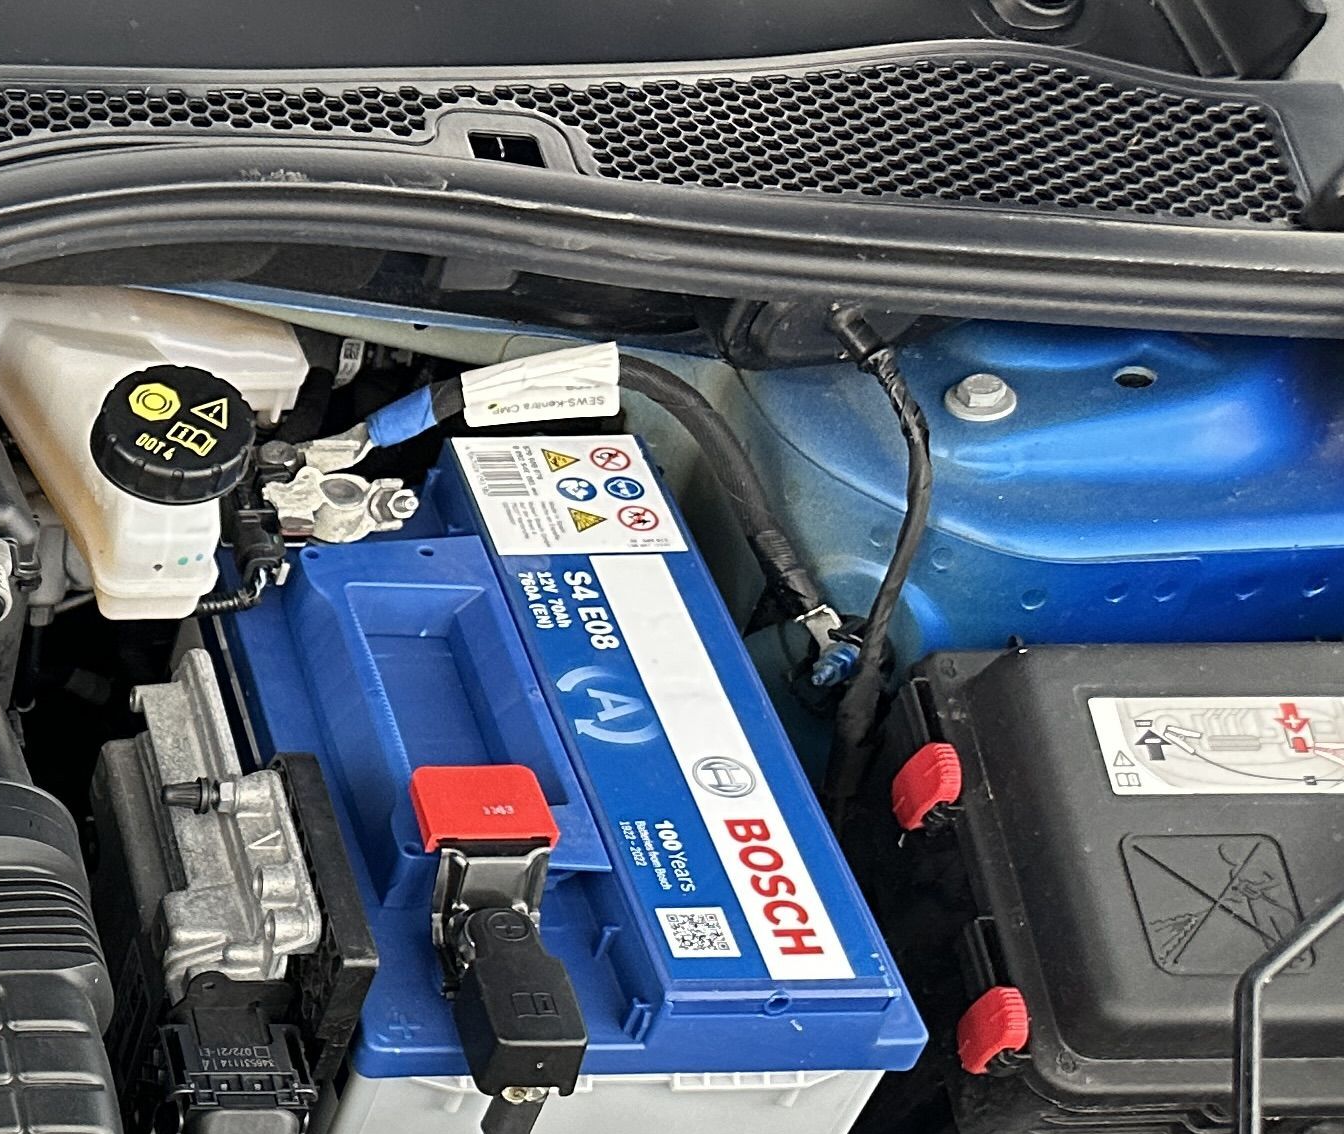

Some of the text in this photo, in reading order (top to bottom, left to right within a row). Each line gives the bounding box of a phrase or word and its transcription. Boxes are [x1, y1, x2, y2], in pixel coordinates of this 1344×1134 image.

[135, 433, 176, 461] DOT 4
[518, 571, 555, 630] 760A (EN)
[536, 571, 572, 628] 12V 70Ah
[564, 571, 620, 649] S4 E08
[654, 820, 696, 893] 100 Years
[723, 819, 825, 956] BOSCH
